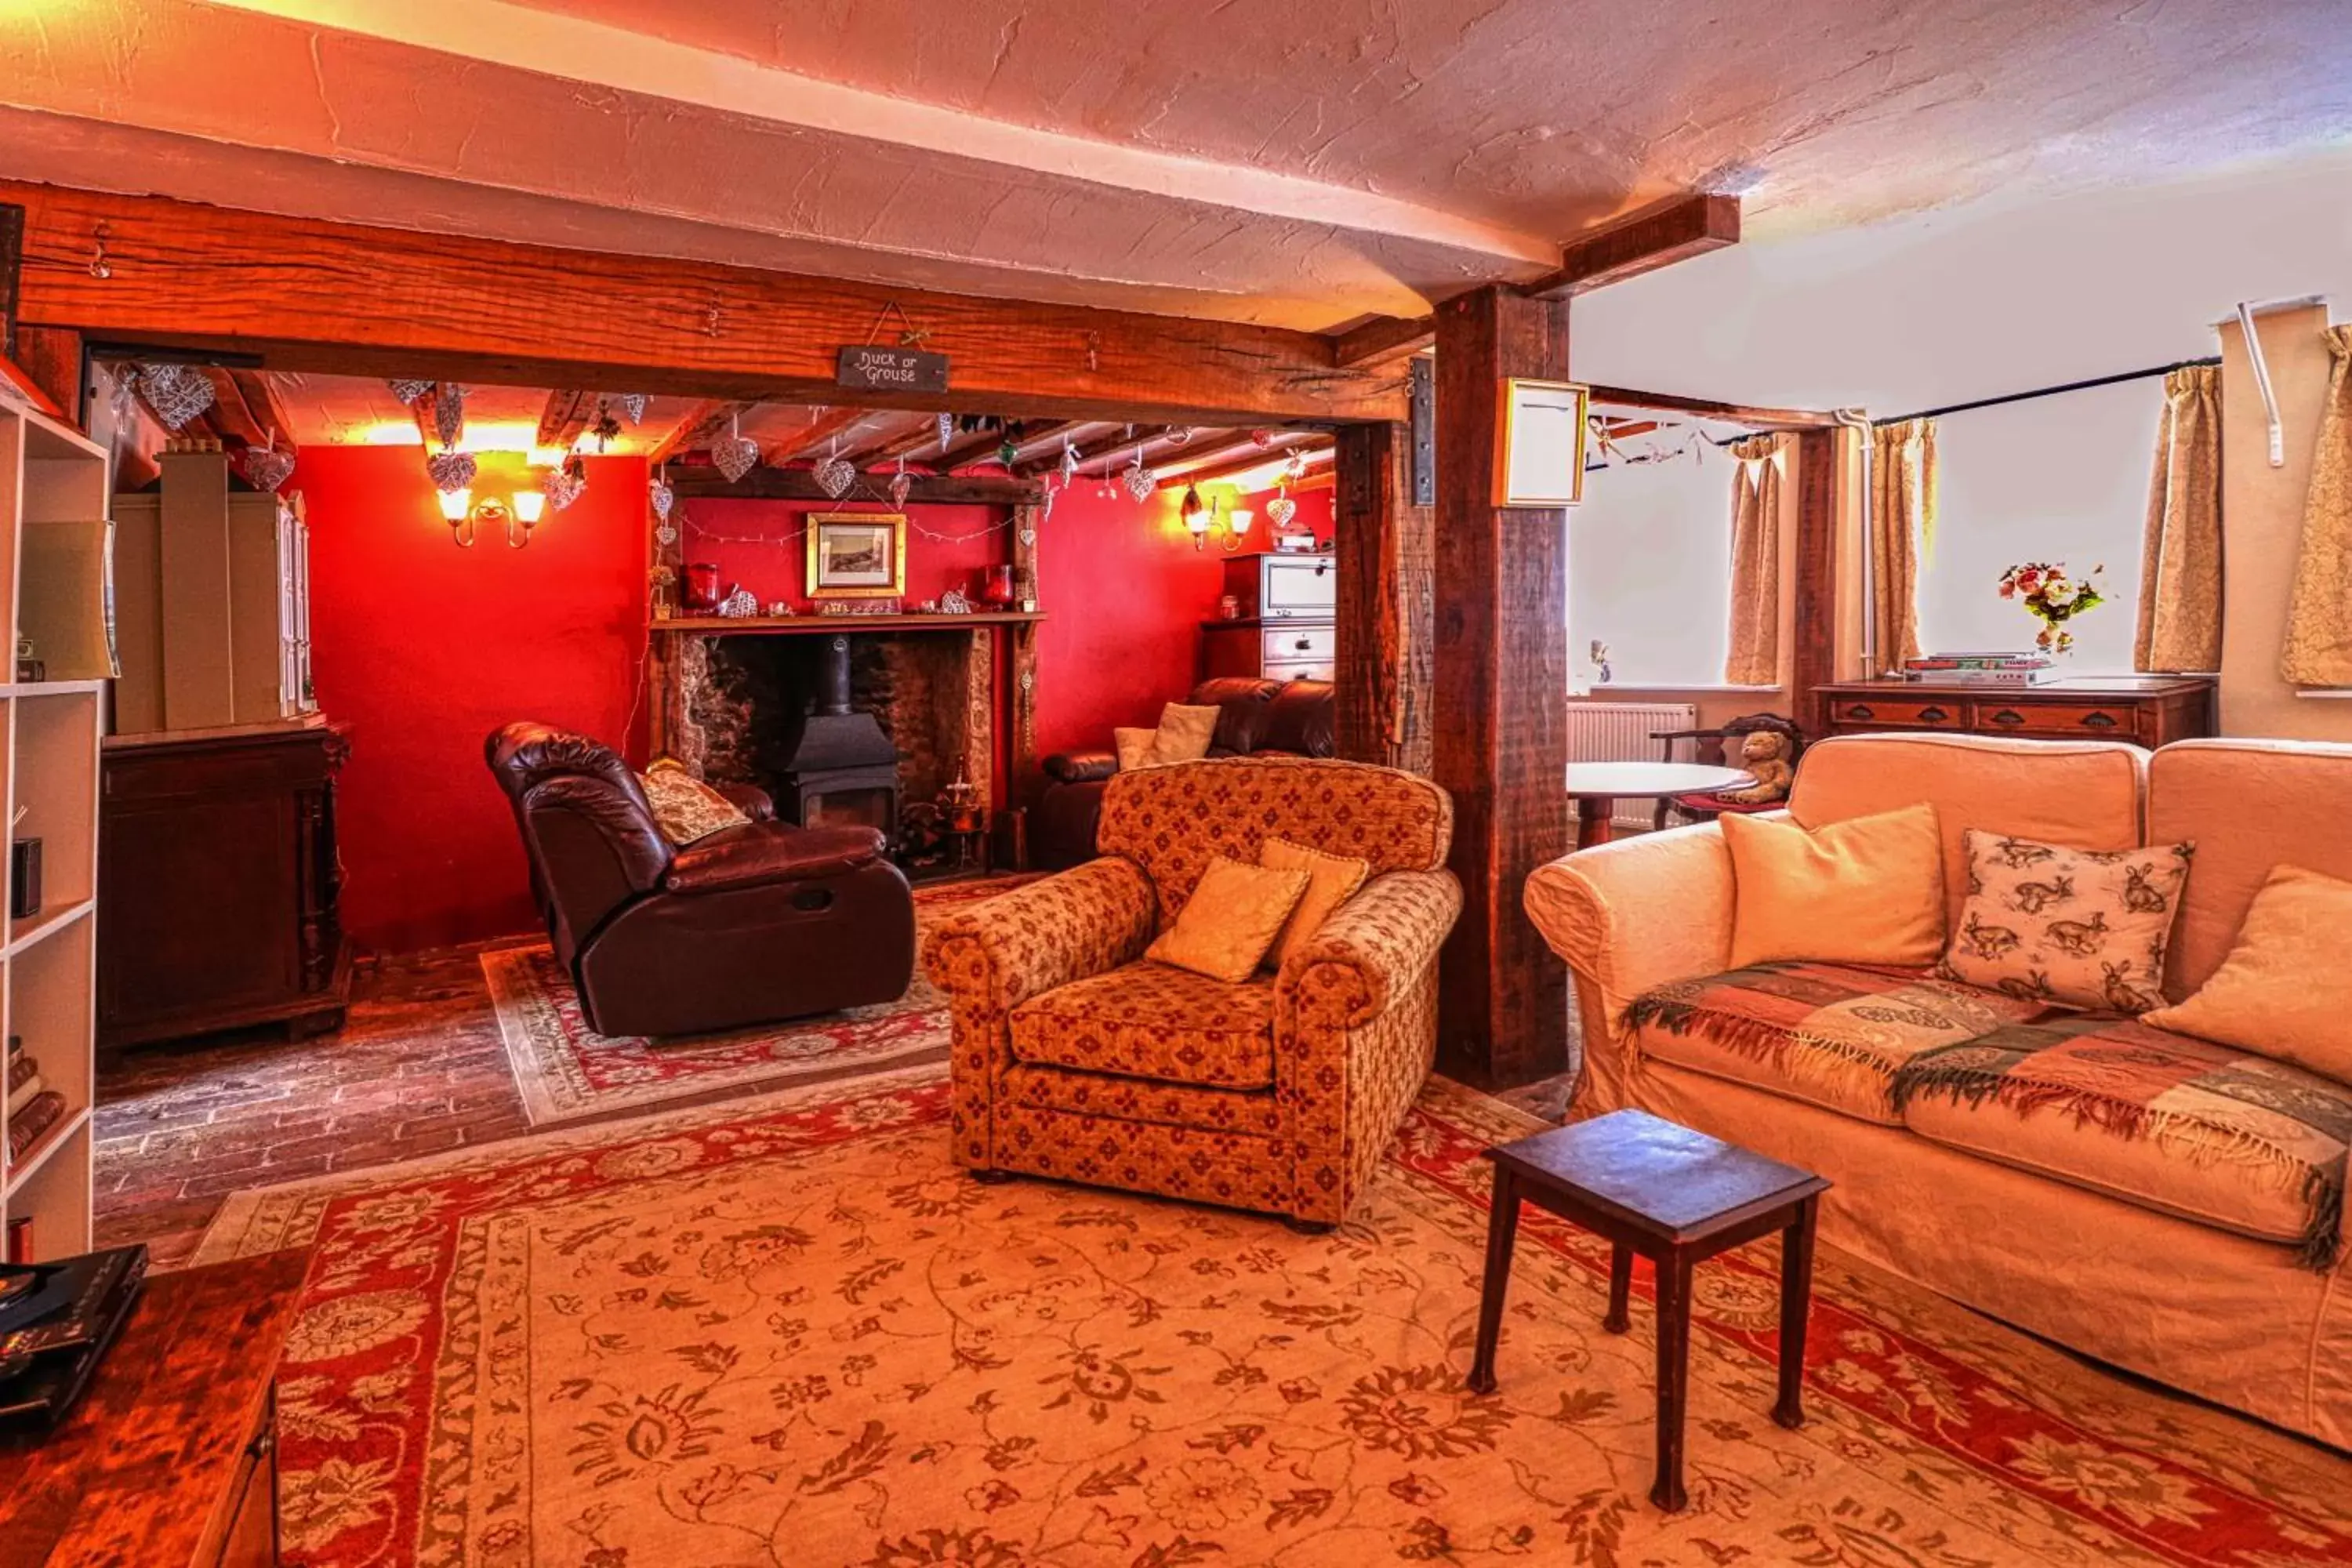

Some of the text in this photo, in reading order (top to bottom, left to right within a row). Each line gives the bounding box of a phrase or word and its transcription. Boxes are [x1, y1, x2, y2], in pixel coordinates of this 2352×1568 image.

[854, 352, 917, 371] Duck or
[866, 366, 916, 385] Grouse
